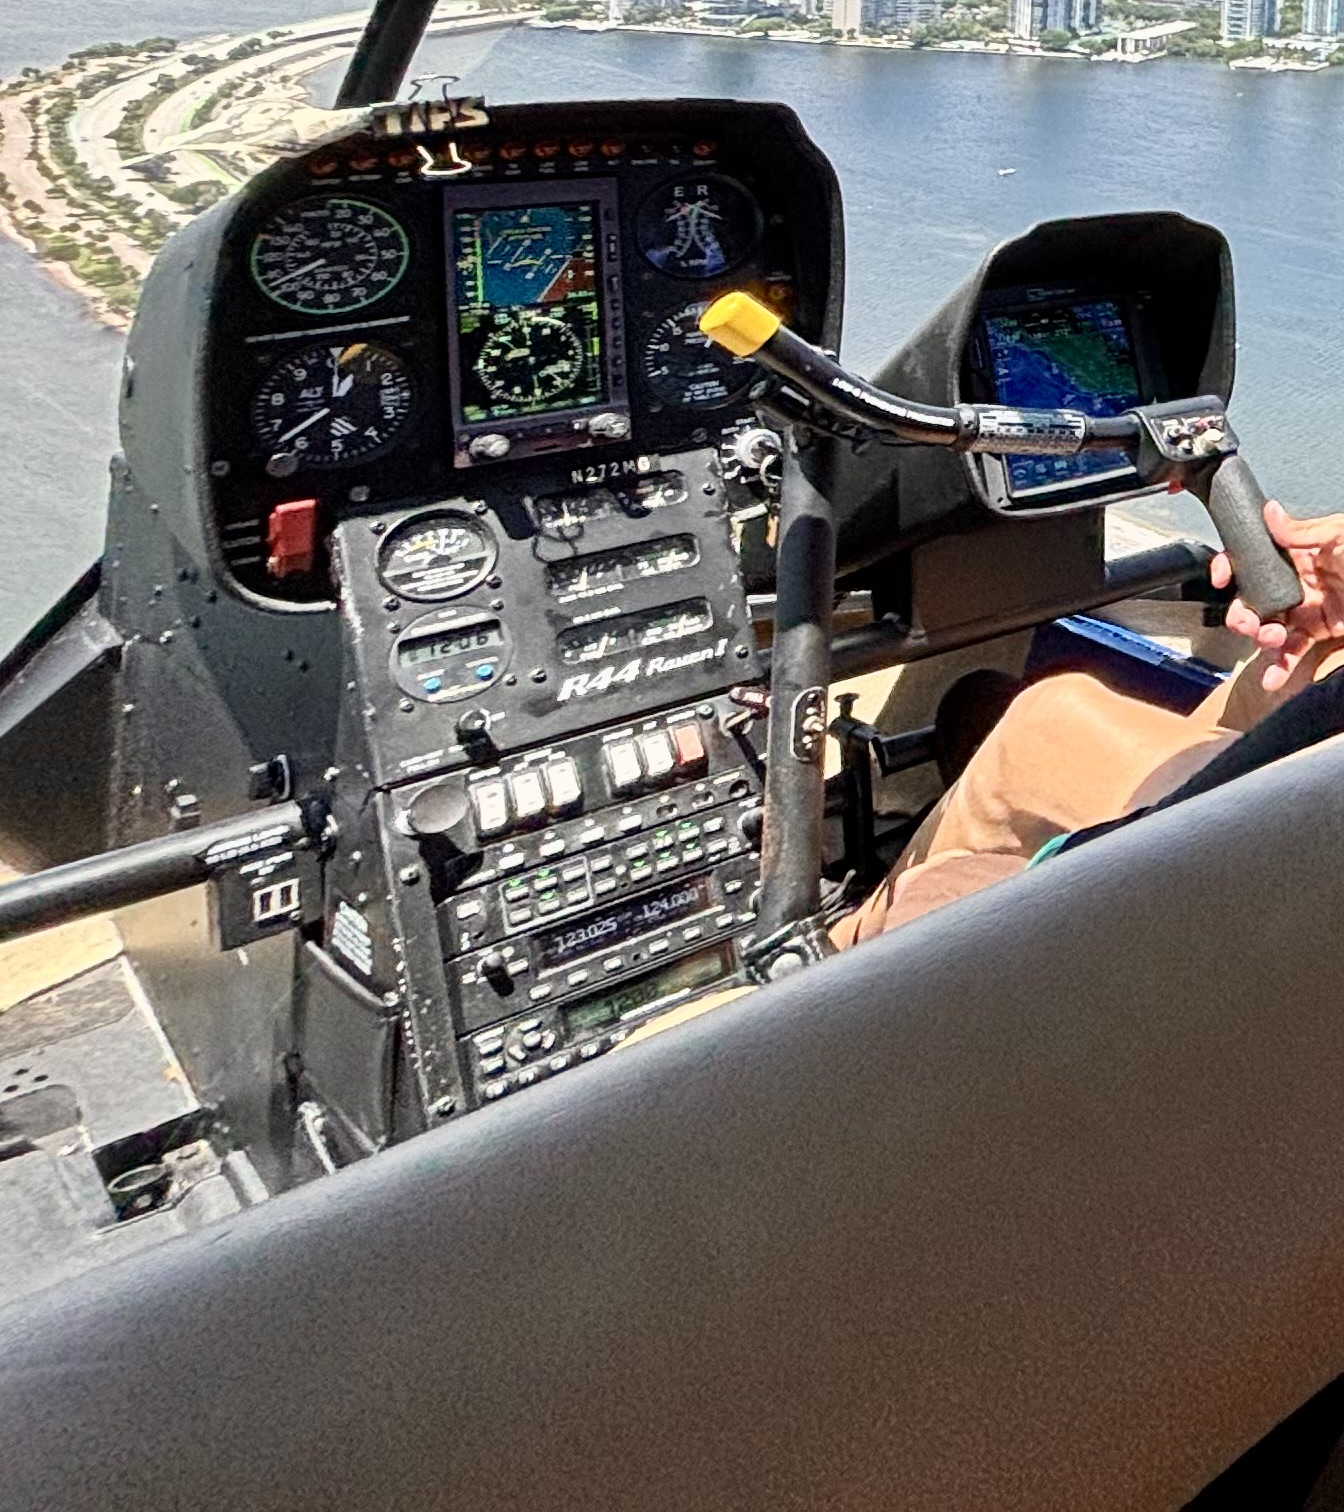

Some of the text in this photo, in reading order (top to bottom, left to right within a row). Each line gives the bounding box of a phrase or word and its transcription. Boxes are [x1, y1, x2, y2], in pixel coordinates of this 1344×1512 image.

[292, 367, 308, 382] 9
[380, 372, 394, 386] 2
[270, 392, 286, 406] 8
[382, 406, 396, 419] 3
[269, 418, 283, 432] 7
[294, 436, 309, 450] 6
[330, 438, 344, 452] 5
[570, 455, 652, 484] N272MG
[556, 658, 642, 702] R44
